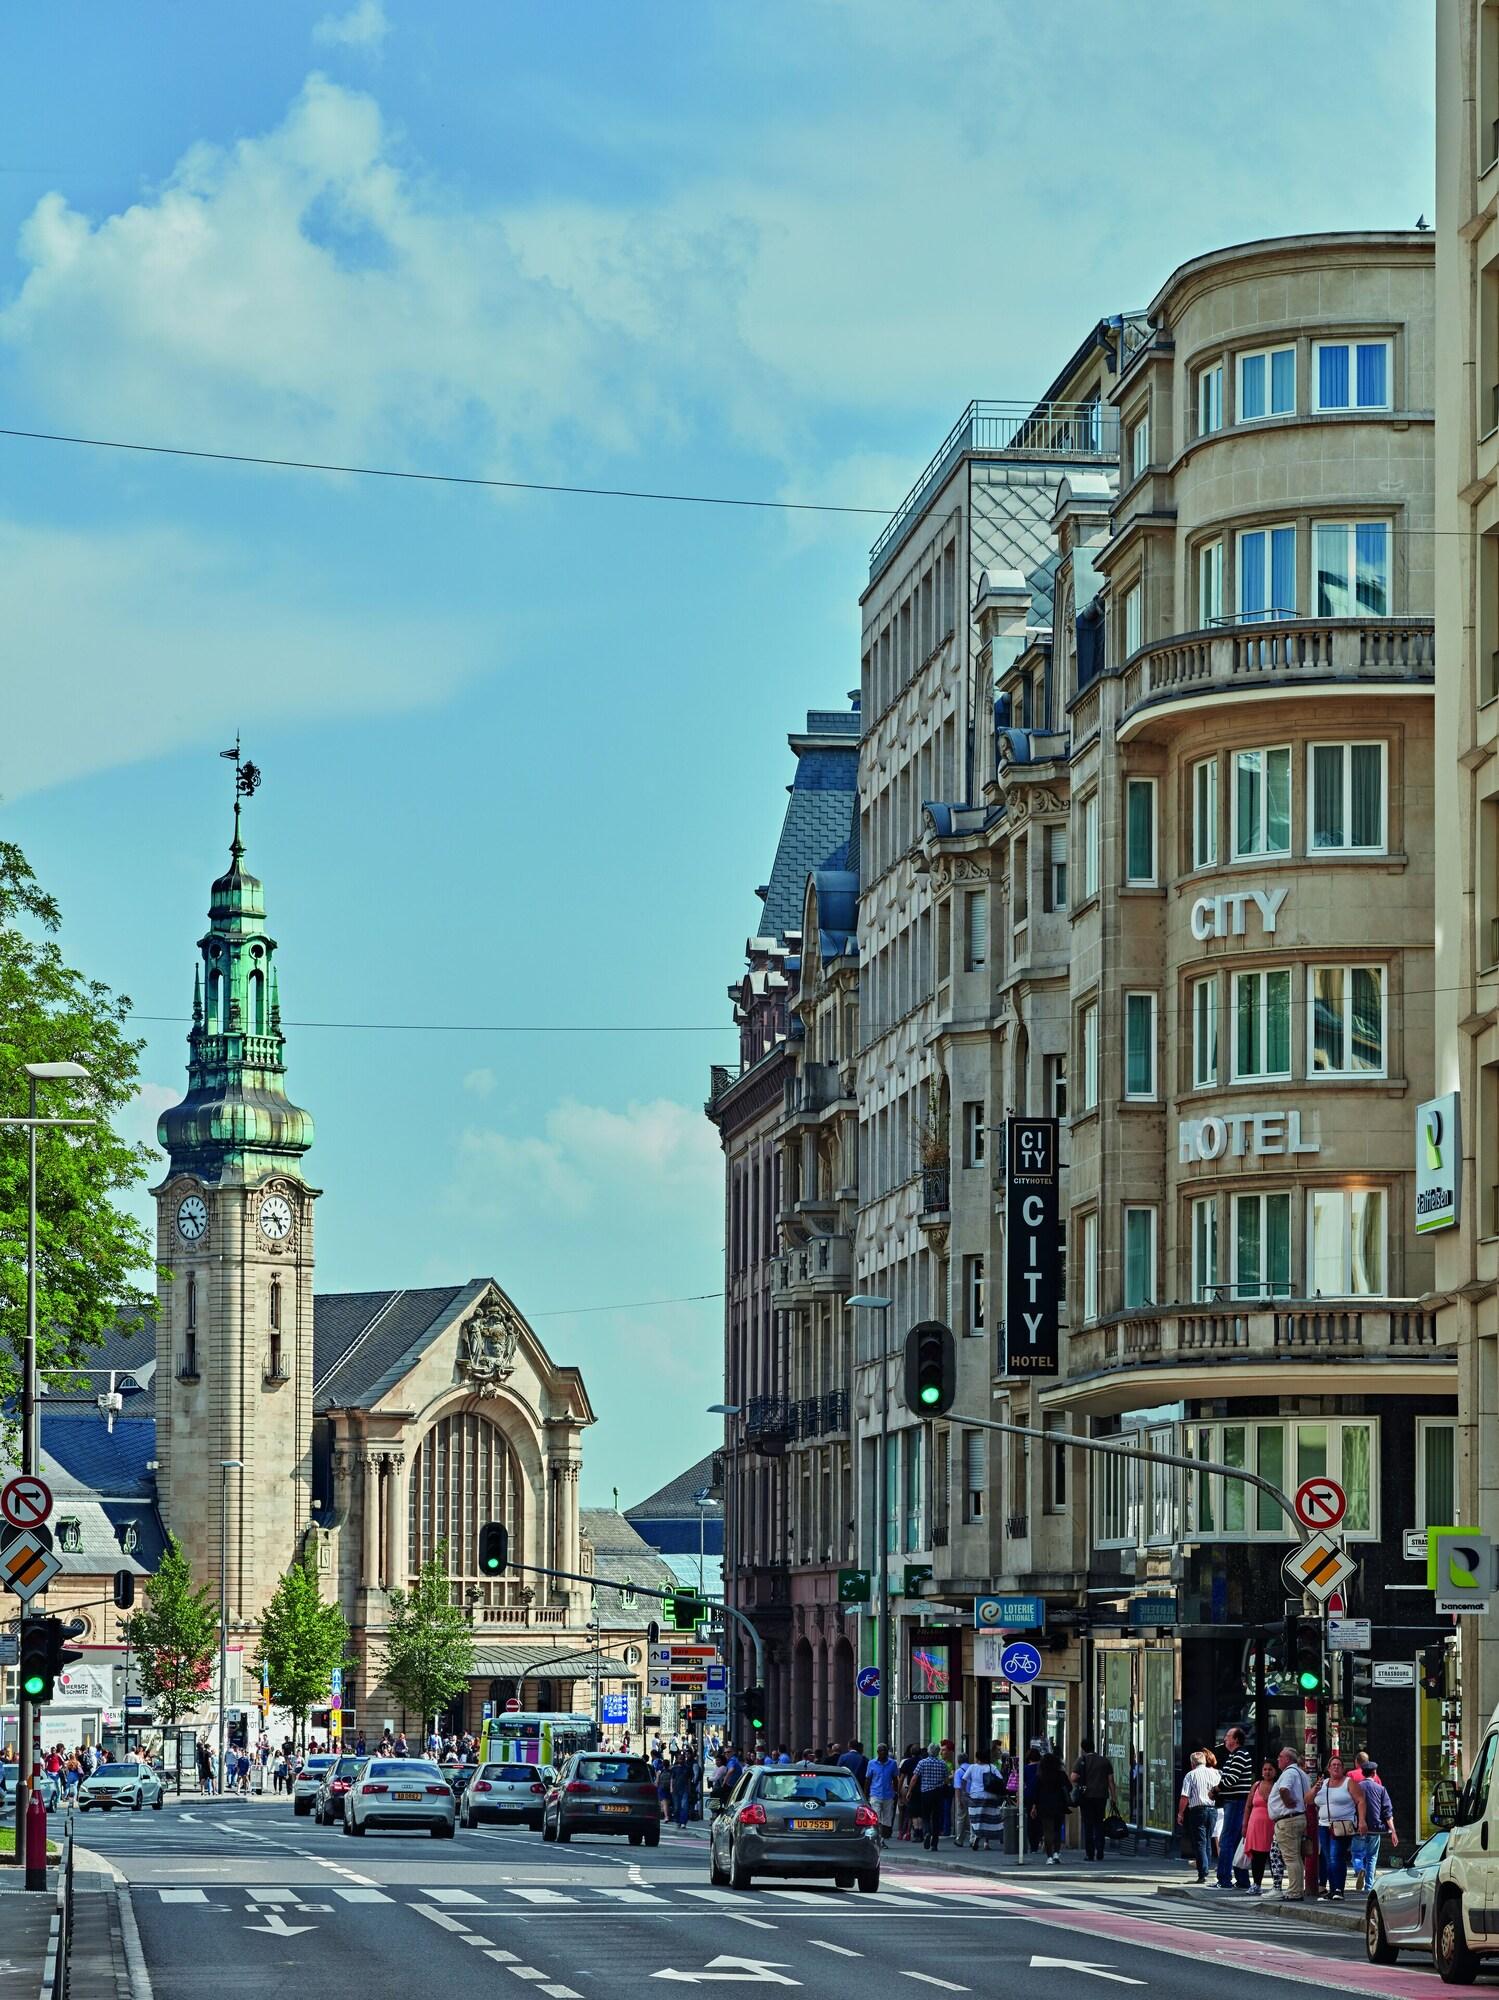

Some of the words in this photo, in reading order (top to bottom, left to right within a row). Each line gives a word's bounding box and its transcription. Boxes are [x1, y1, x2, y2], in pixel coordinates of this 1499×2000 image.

[1190, 888, 1289, 941] CITY
[1179, 1110, 1320, 1164] HOTEL
[1013, 1177, 1054, 1185] CITYHOTEL
[1416, 1189, 1450, 1214] Raiffeisen
[1022, 1195, 1044, 1344] CITY
[1011, 1355, 1055, 1368] HOTEL
[1003, 1604, 1035, 1615] LOTERIE
[1441, 1602, 1485, 1611] bancomat
[1003, 1614, 1035, 1622] NATIONALE
[809, 1820, 830, 1829] 7529
